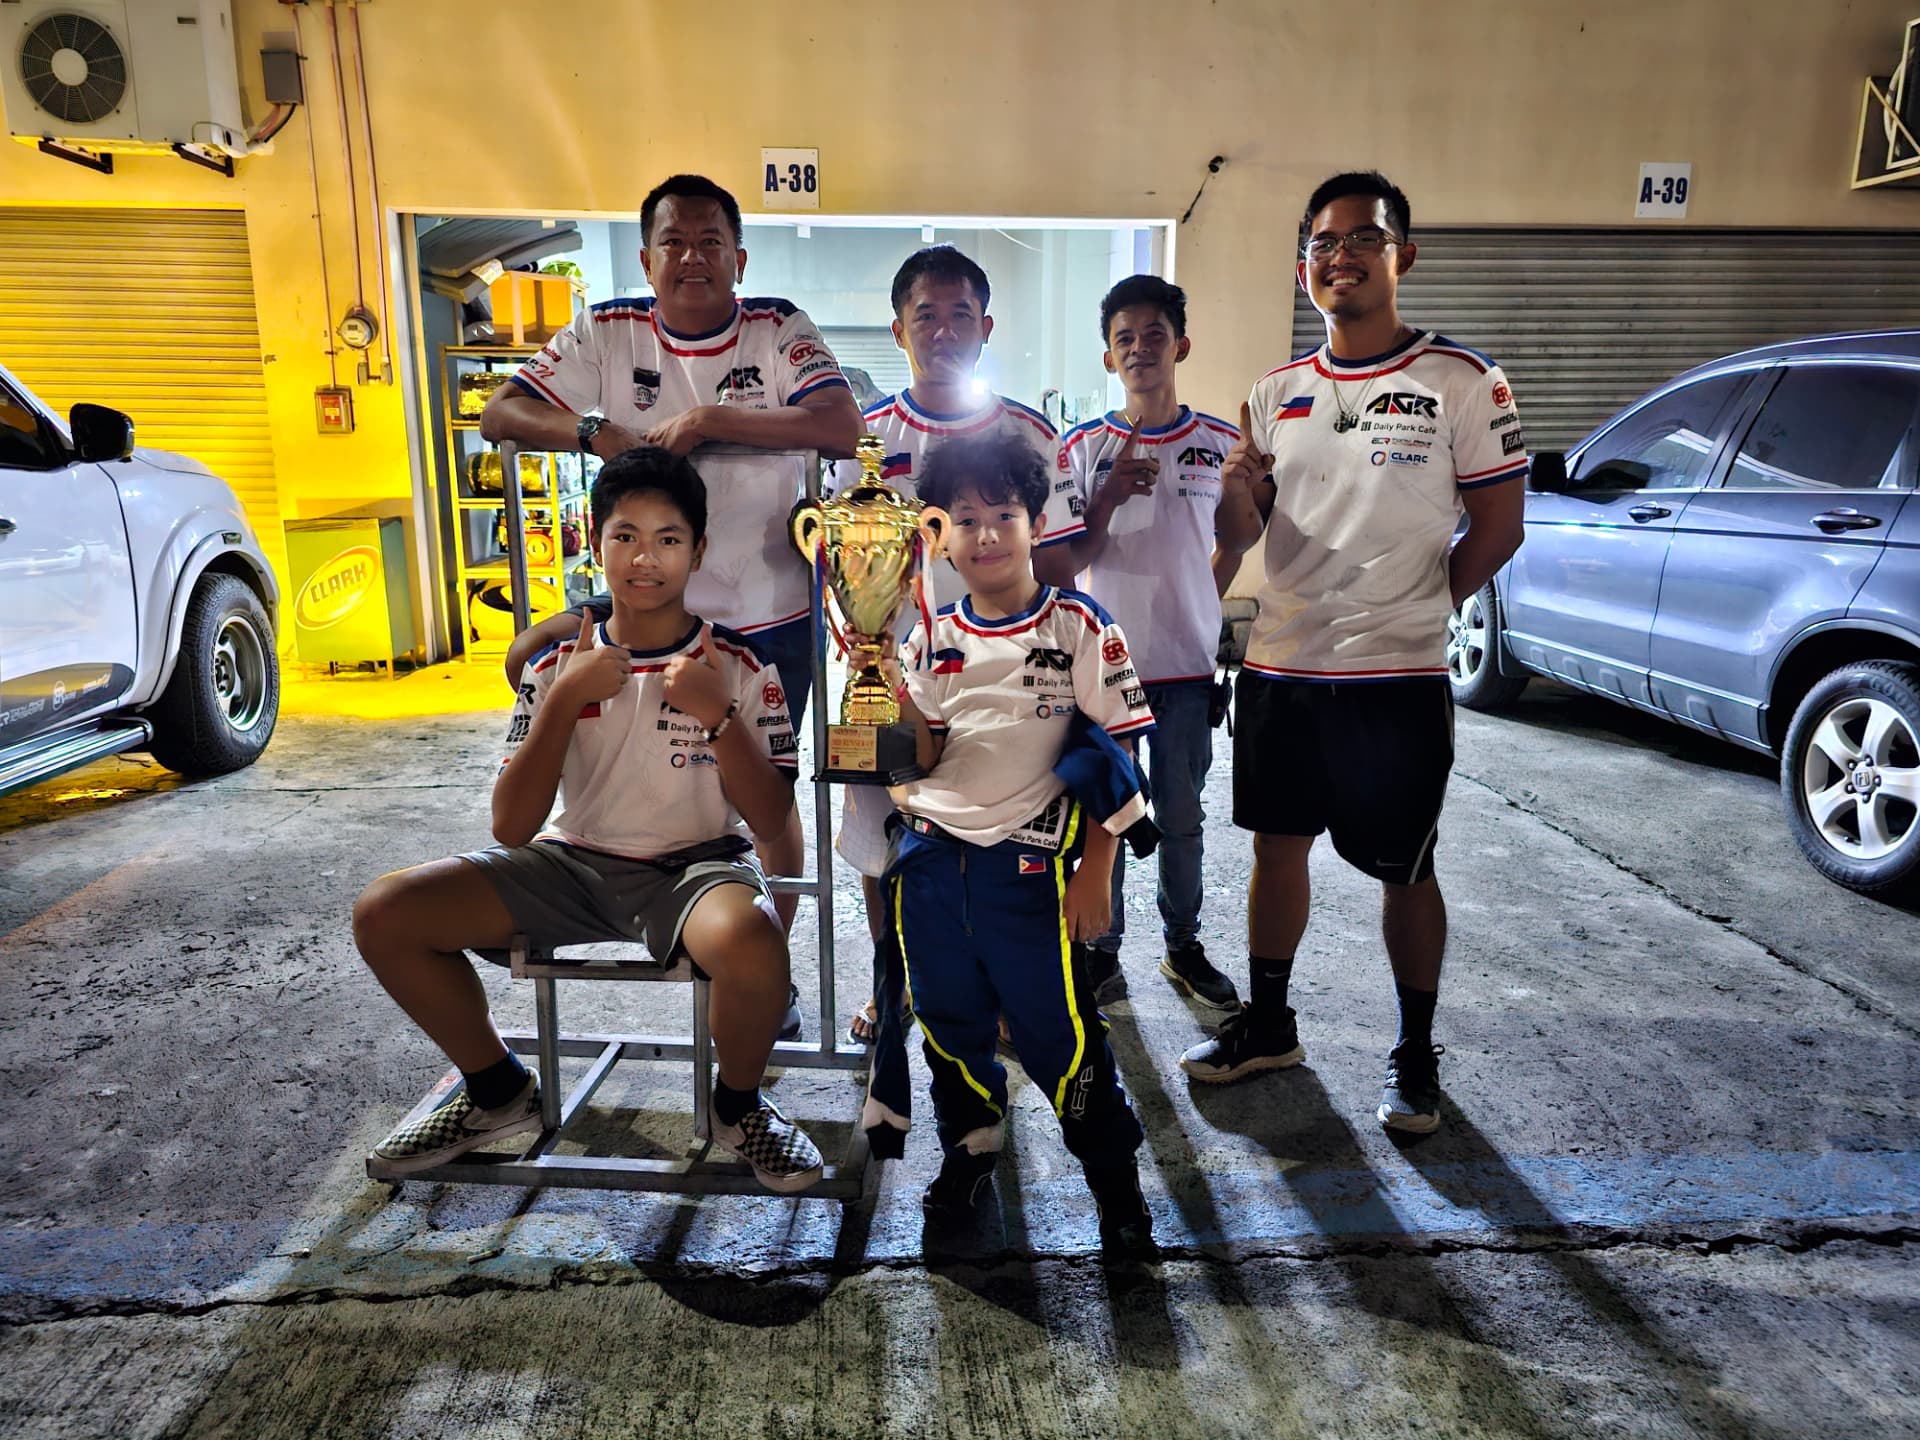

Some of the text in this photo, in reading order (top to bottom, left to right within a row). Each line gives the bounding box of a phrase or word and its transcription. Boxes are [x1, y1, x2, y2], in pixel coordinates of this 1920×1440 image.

[765, 164, 817, 193] A-38
[1640, 177, 1688, 204] A-39
[1374, 422, 1437, 435] Daily Park Café
[1391, 452, 1428, 464] CLARC
[310, 561, 368, 604] CLARK
[670, 723, 692, 736] Daily
[1027, 835, 1042, 845] Park
